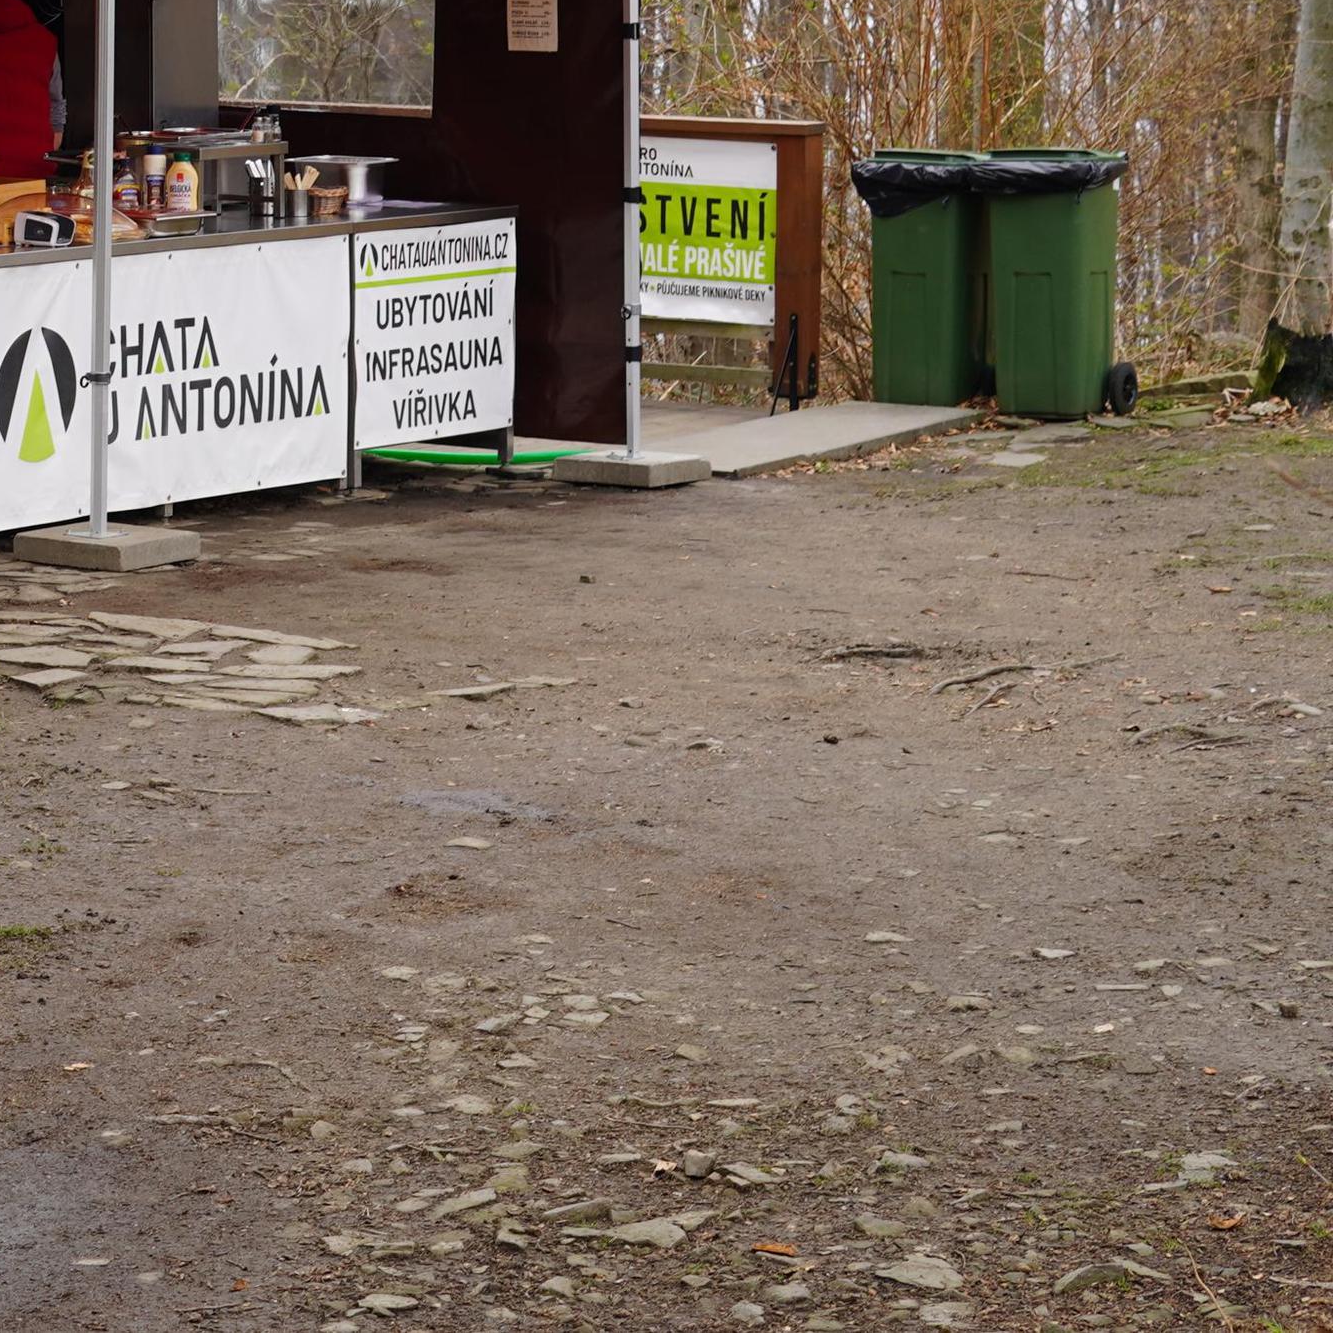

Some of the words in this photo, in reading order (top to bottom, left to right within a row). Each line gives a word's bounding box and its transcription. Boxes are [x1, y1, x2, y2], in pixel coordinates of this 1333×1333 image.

[639, 159, 694, 178] TONÍNA
[640, 192, 768, 242] TVENÍ
[381, 232, 509, 272] CHATAUANTONINA.CZ
[684, 241, 767, 280] PRAŠIVÉ
[376, 278, 494, 331] UBYTOVÁNÍ
[656, 280, 701, 297] PŮJČUJEME
[702, 285, 743, 301] PIKNIKOVÉ
[745, 289, 766, 302] DEKY
[109, 315, 220, 379] HATA
[365, 335, 503, 383] INFRASAUNA
[135, 352, 331, 442] ANTONÍNA
[392, 387, 478, 430] VÍŘIVKA
